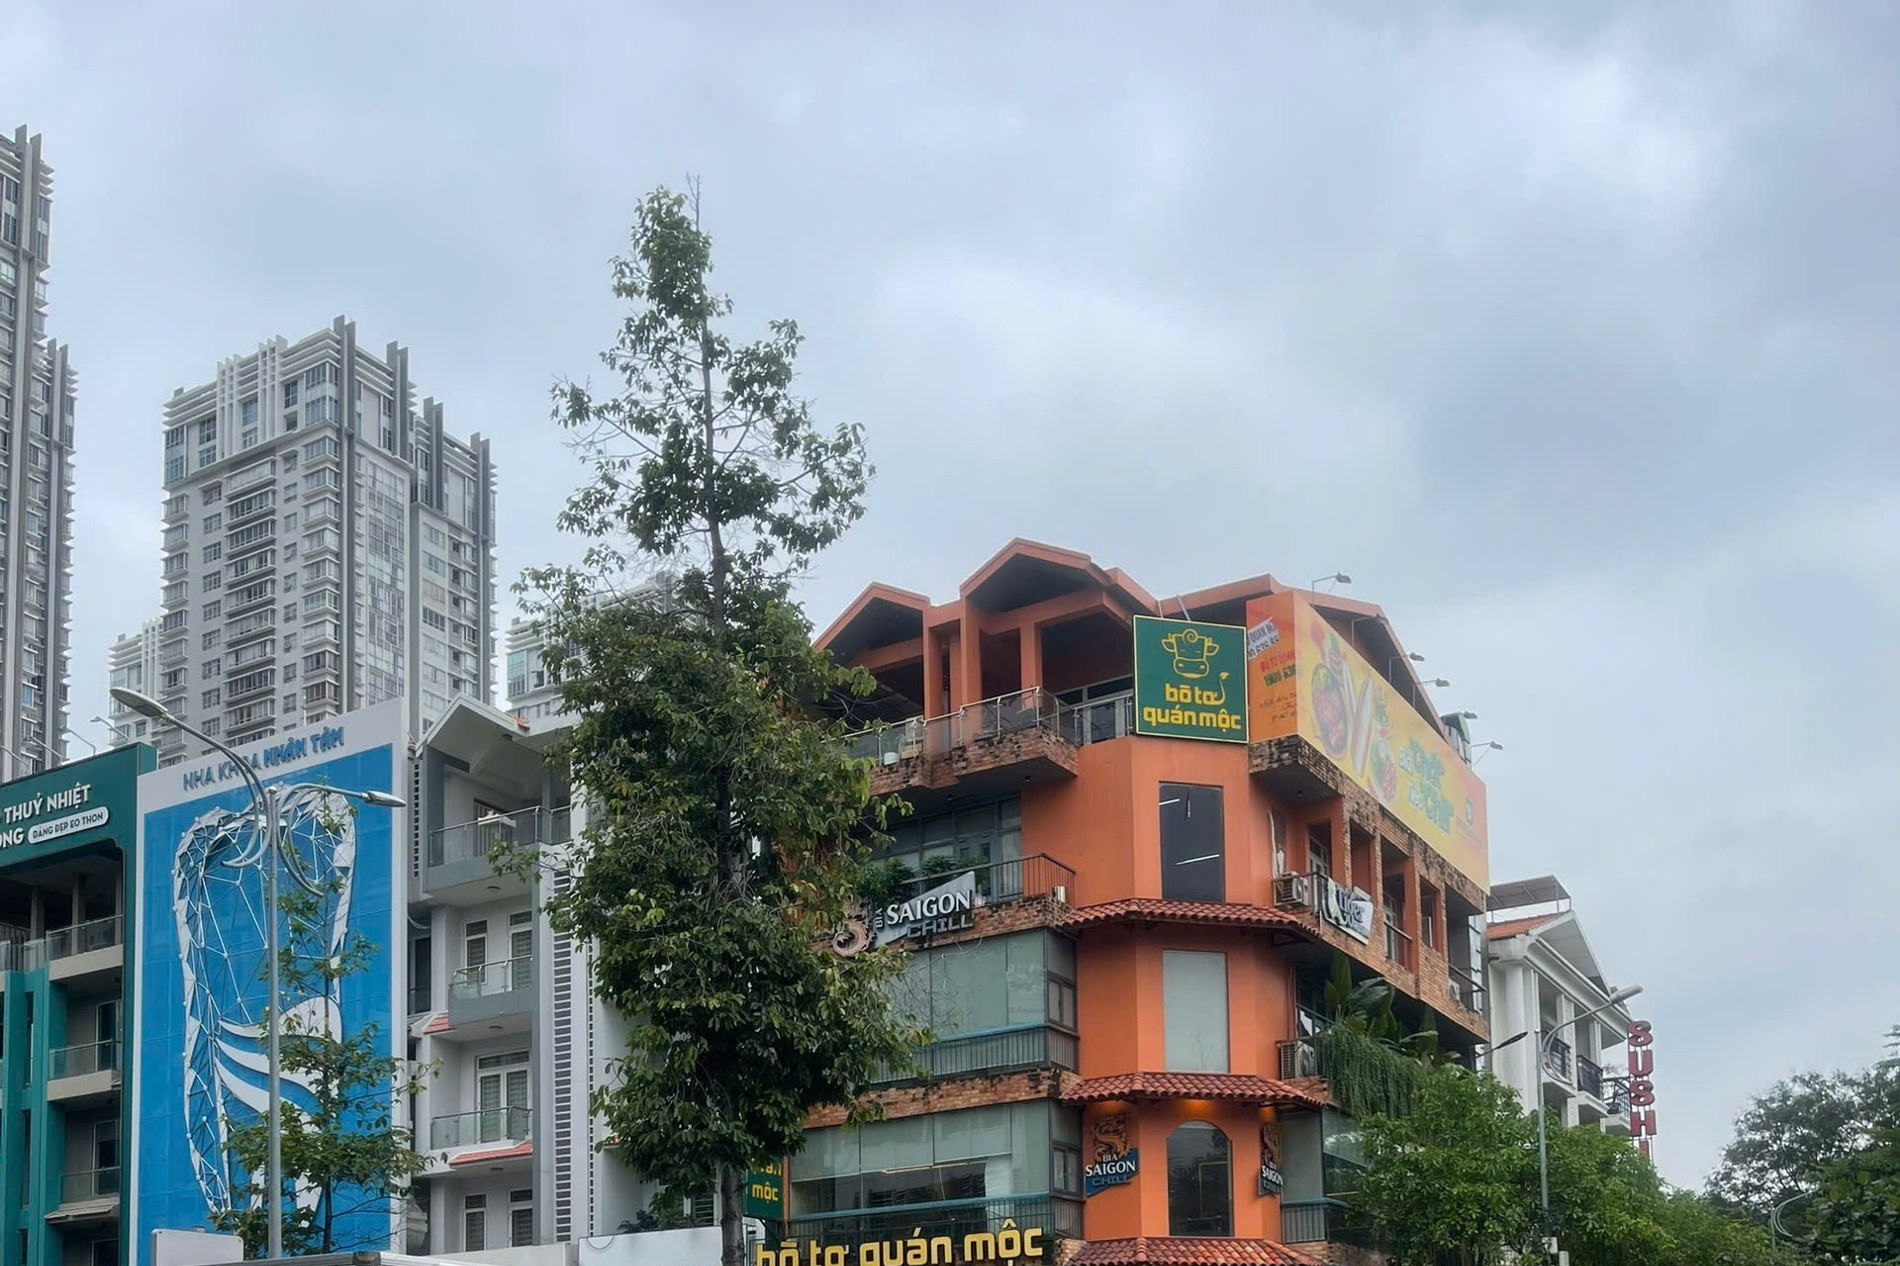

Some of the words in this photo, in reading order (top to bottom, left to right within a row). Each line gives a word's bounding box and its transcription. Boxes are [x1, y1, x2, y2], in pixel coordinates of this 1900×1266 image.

[1143, 704, 1197, 727] quán
[1199, 708, 1242, 733] mộc
[183, 766, 215, 791] NHA
[4, 792, 43, 824] THUỶ
[47, 781, 91, 813] NHIỆT
[82, 811, 104, 826] THON
[0, 827, 24, 848] NG
[875, 907, 883, 929] BIA
[886, 889, 972, 926] SAIGON
[907, 914, 974, 938] CHILL
[1085, 1160, 1136, 1178] SAIGON
[1102, 1153, 1118, 1163] BIA
[752, 1181, 778, 1203] mộc
[964, 1218, 1043, 1266] mộc
